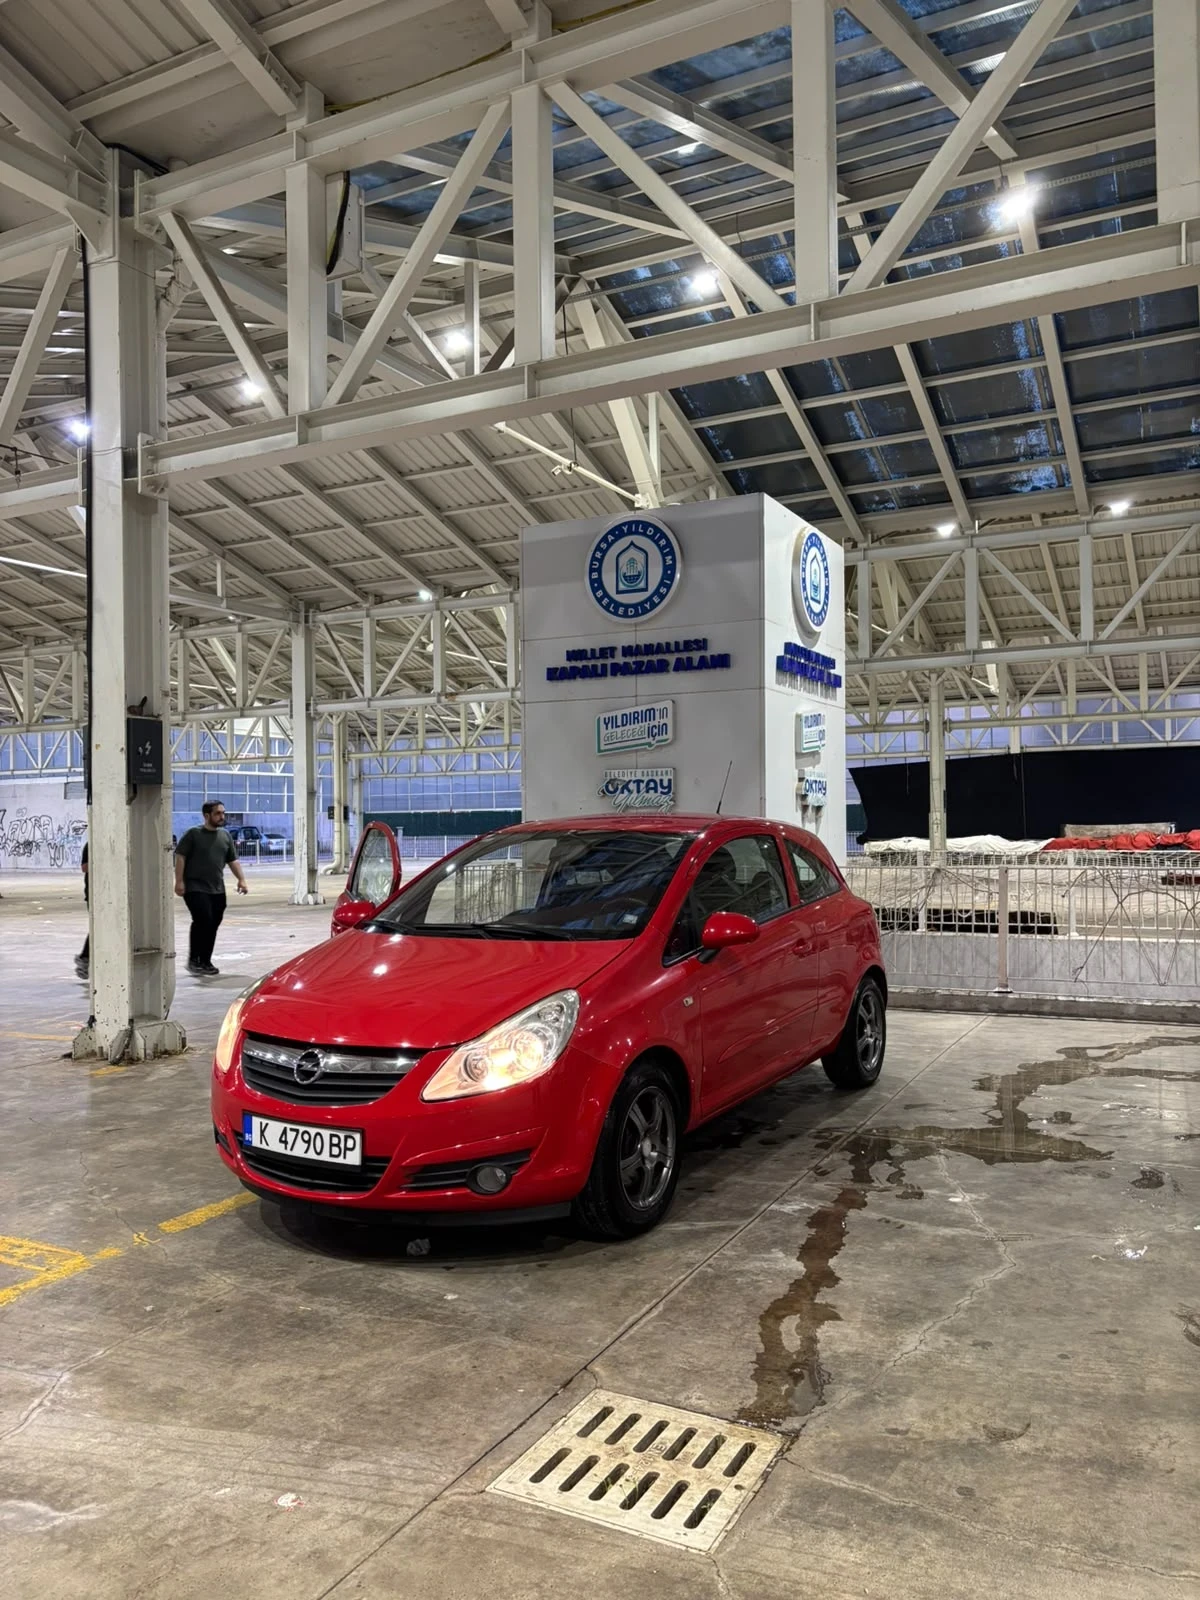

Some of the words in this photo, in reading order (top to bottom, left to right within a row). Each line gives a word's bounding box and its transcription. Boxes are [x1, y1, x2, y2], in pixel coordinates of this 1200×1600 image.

[592, 534, 615, 579] BURSA
[622, 523, 673, 565] YILDIRIM
[546, 663, 608, 681] KAPALI
[610, 659, 671, 677] PAZAR
[604, 778, 673, 796] OKTAY
[804, 779, 827, 796] OKTAY
[259, 1121, 269, 1147] K
